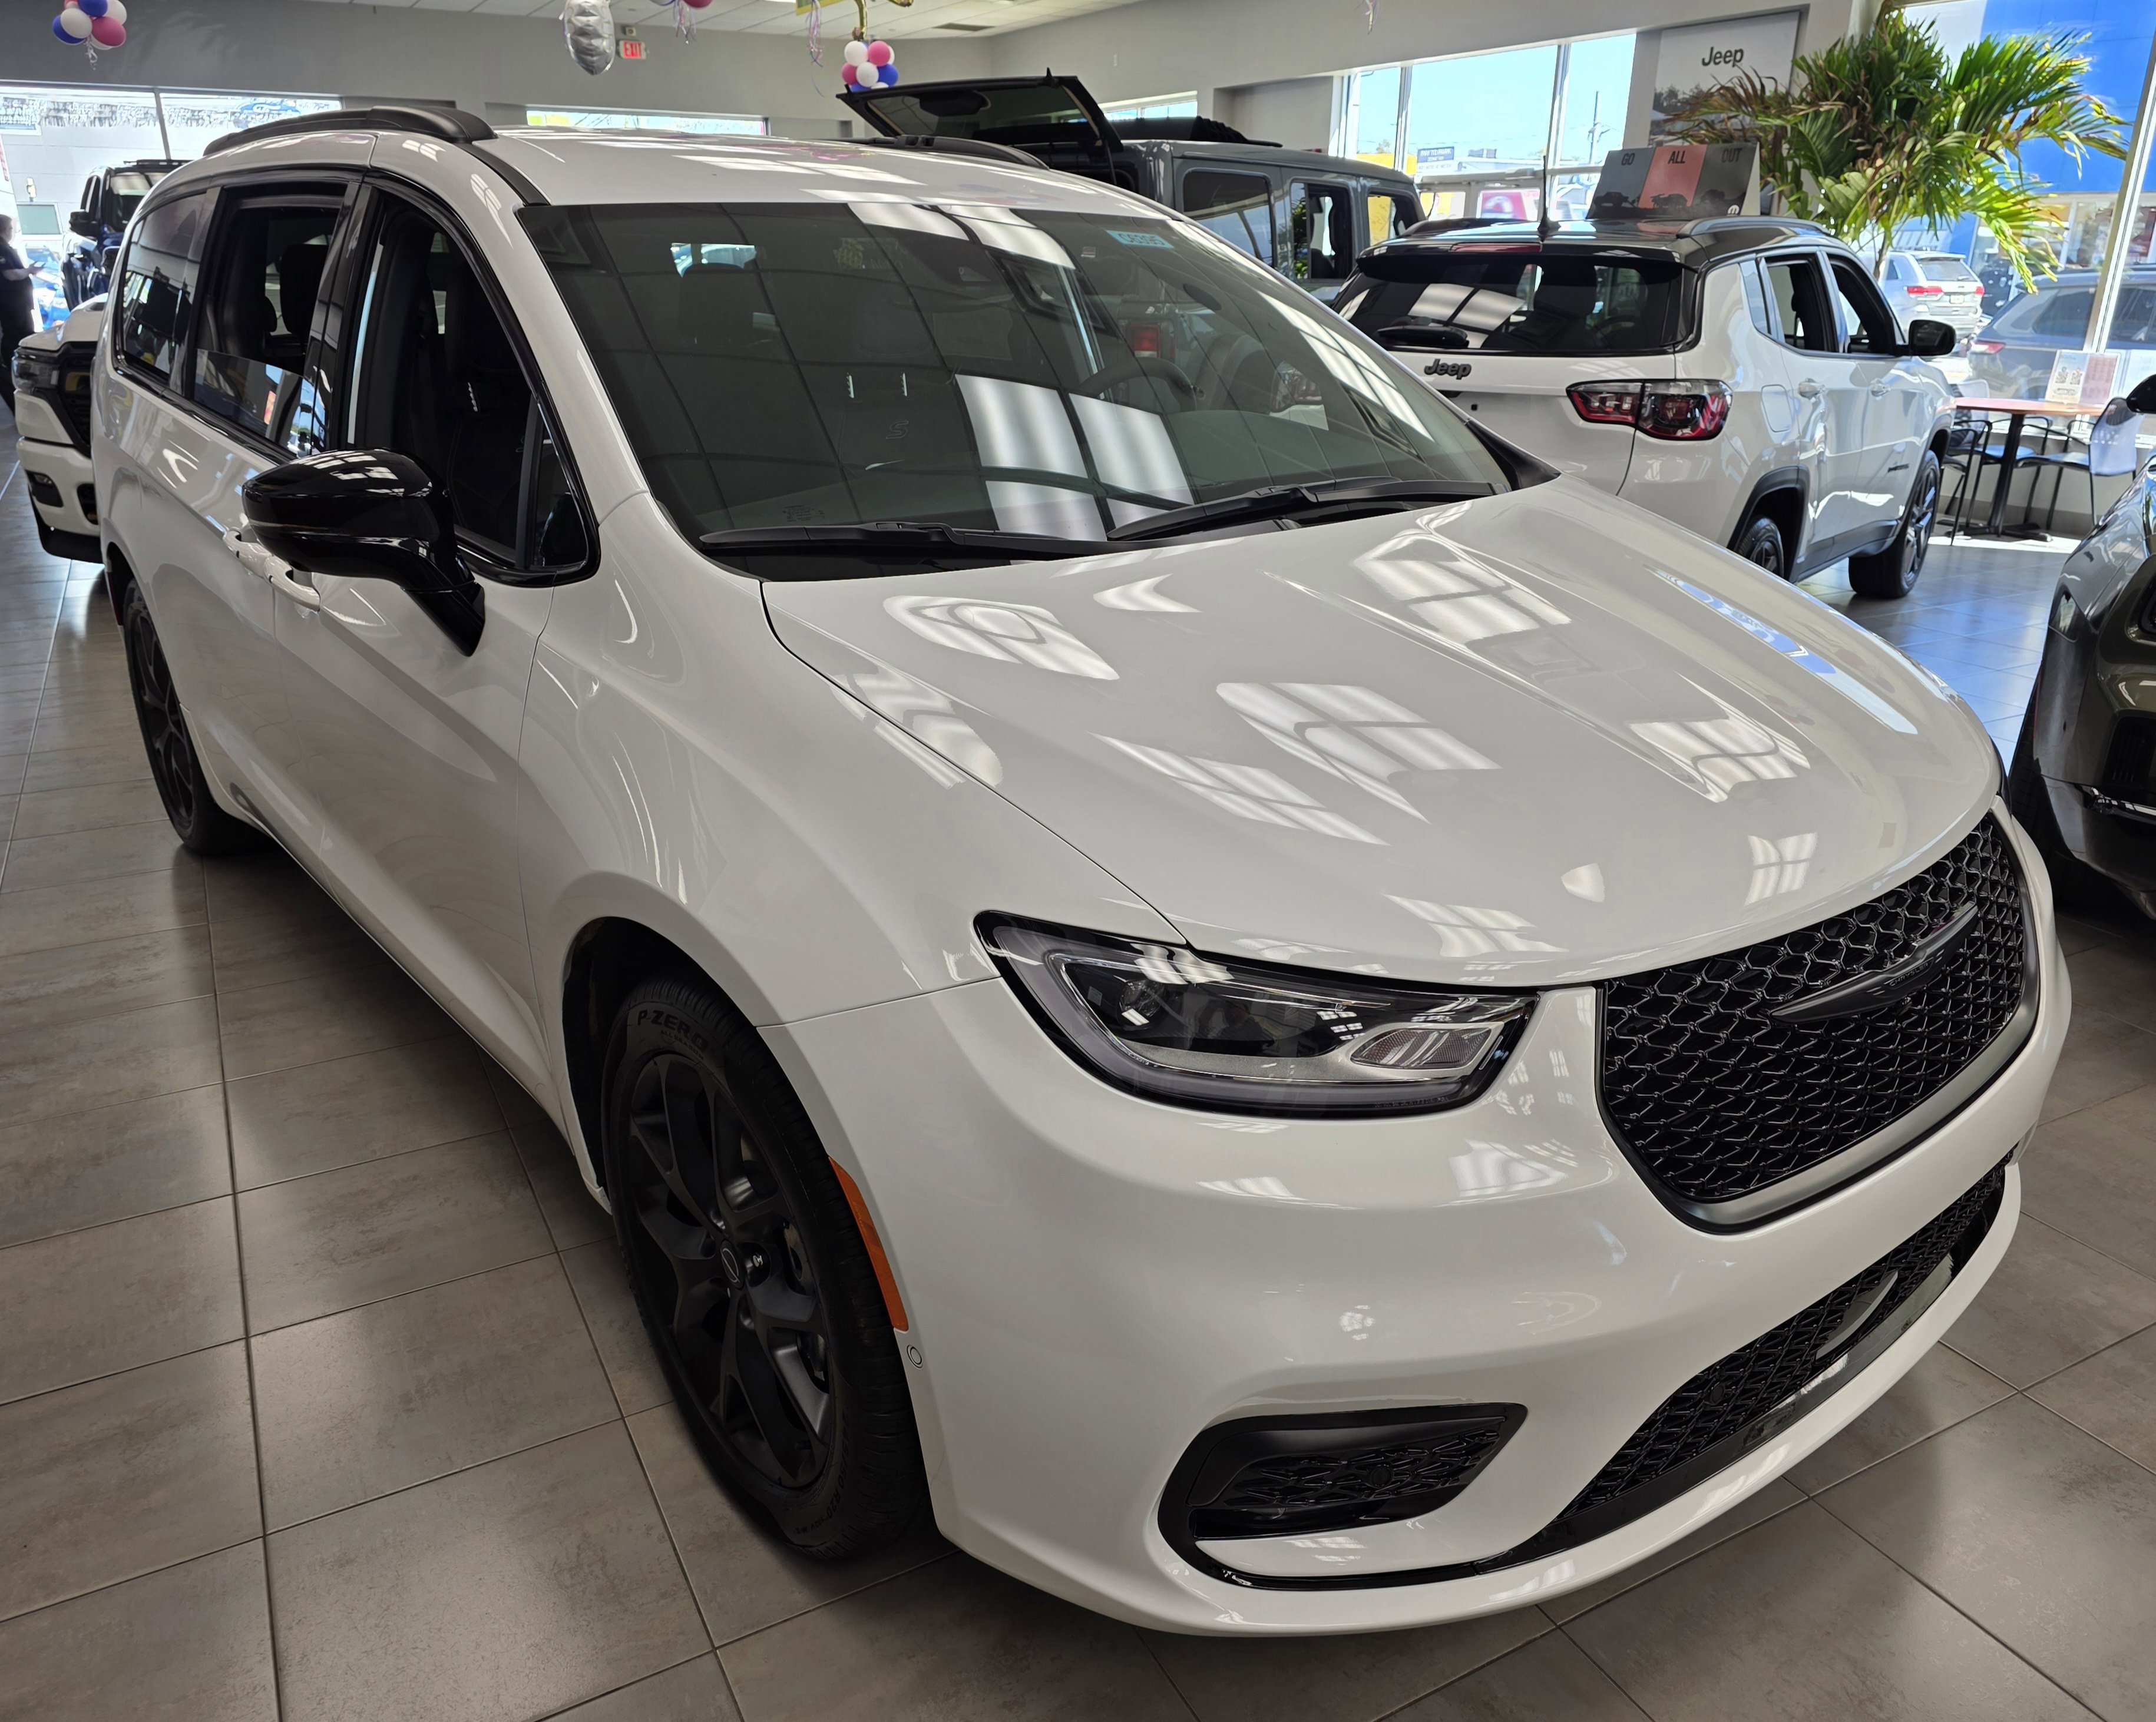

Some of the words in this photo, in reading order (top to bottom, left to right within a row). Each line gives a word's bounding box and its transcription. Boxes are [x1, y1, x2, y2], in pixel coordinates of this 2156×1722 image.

[623, 41, 641, 58] EXIT
[1702, 47, 1744, 67] Jeep
[1621, 153, 1635, 165] GO
[1668, 150, 1686, 164] ALL
[1721, 148, 1743, 163] OUT
[1424, 359, 1471, 380] Jeep
[886, 420, 909, 439] S
[1889, 962, 1929, 986] CHRYSLER
[660, 1029, 673, 1038] ALL
